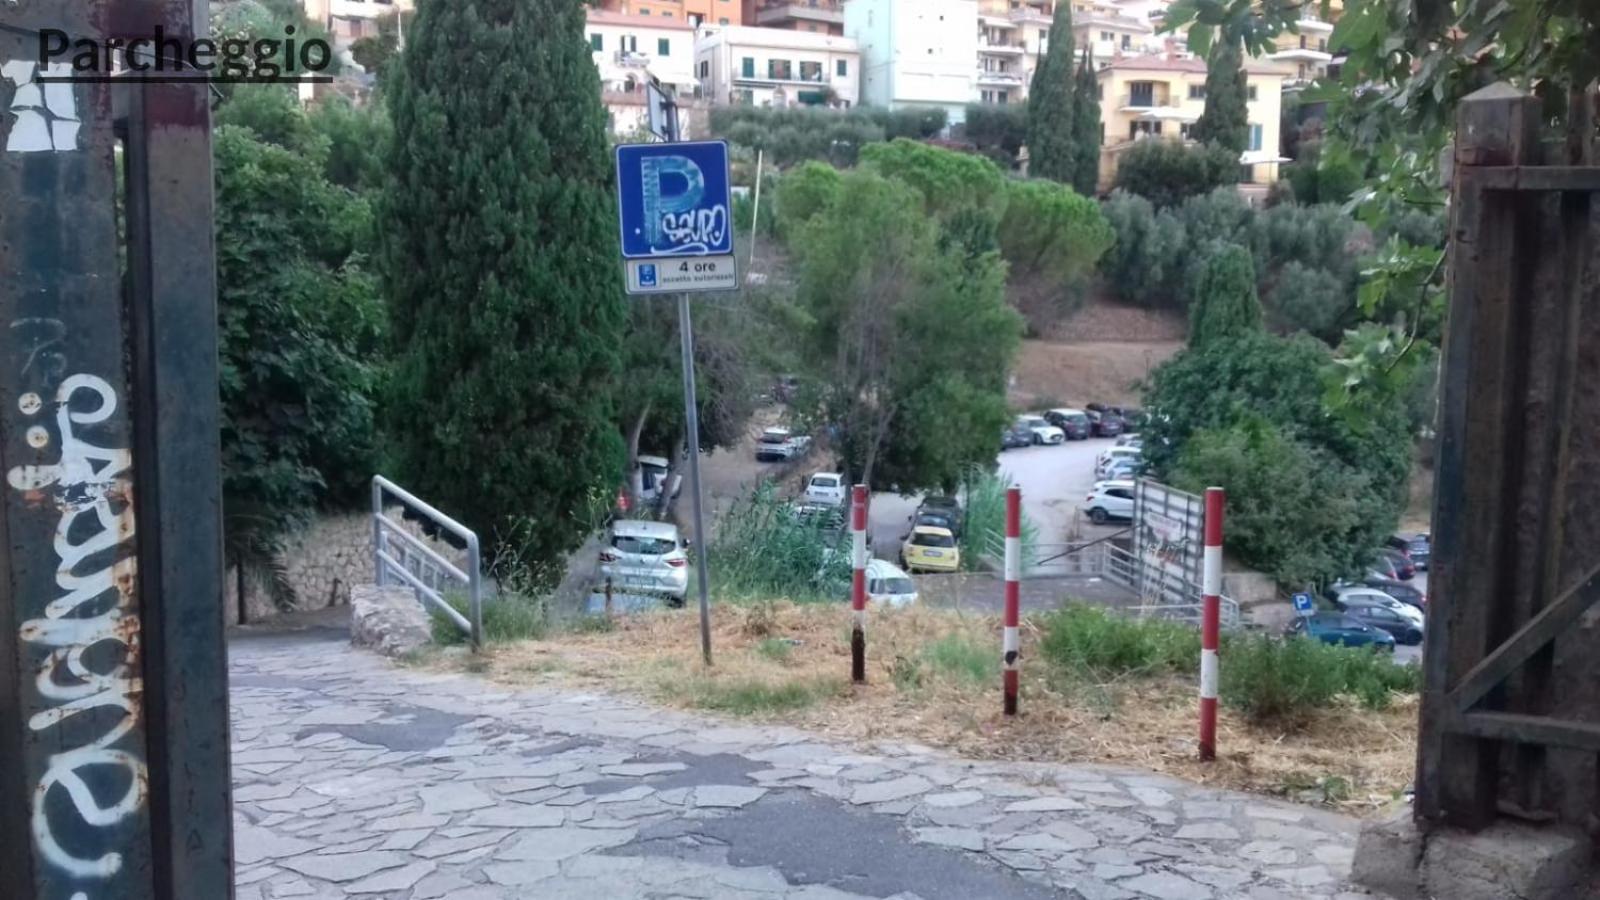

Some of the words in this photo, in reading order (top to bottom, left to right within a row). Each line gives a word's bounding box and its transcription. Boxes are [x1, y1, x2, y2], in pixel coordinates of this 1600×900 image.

[641, 155, 705, 245] P
[679, 261, 689, 272] 4
[694, 262, 716, 272] ore
[1295, 595, 1308, 609] P
